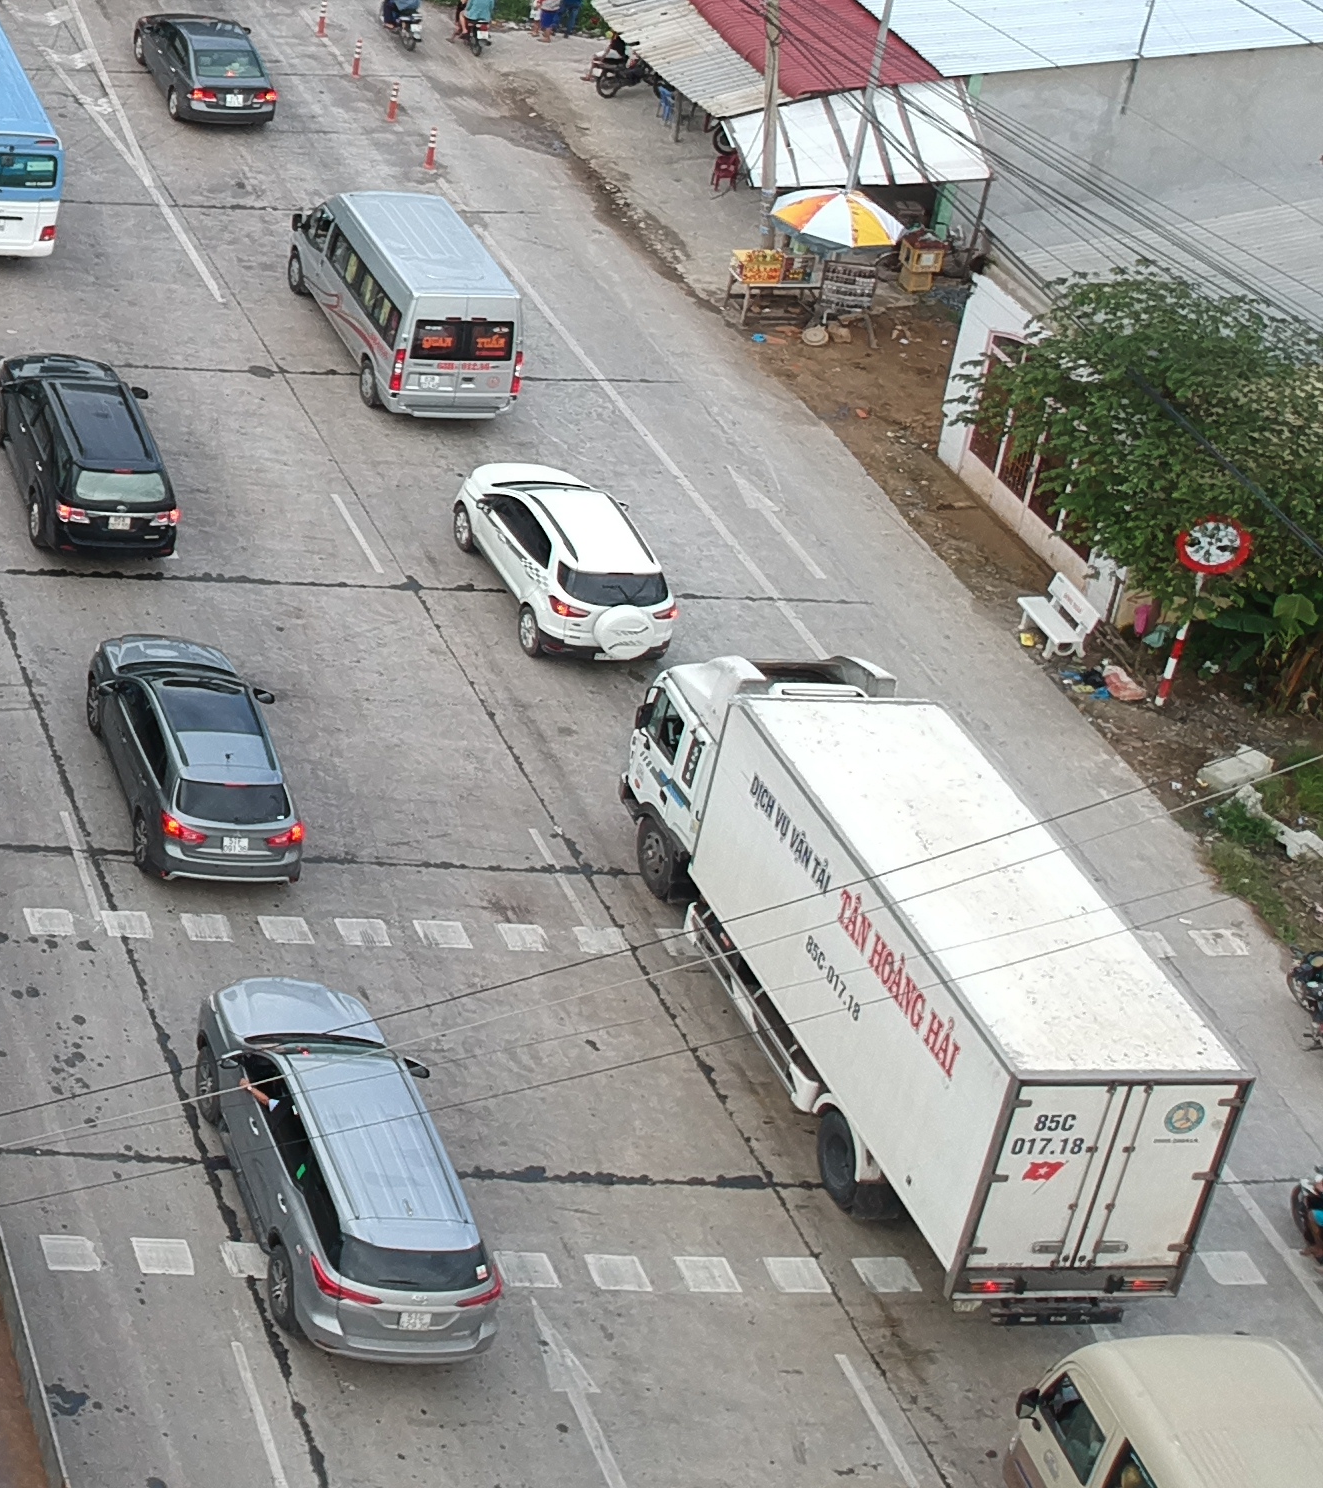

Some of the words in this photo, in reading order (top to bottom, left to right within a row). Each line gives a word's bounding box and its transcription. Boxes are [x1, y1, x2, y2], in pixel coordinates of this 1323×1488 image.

[750, 772, 776, 820] DỊCH
[775, 805, 792, 843] VỤ
[788, 825, 814, 872] VẬN
[811, 857, 832, 895] TẢI
[805, 935, 861, 1021] 85C-017.18
[923, 1008, 961, 1081] HẢI
[1010, 1137, 1085, 1155] 017.18
[1033, 1114, 1076, 1132] 85C
